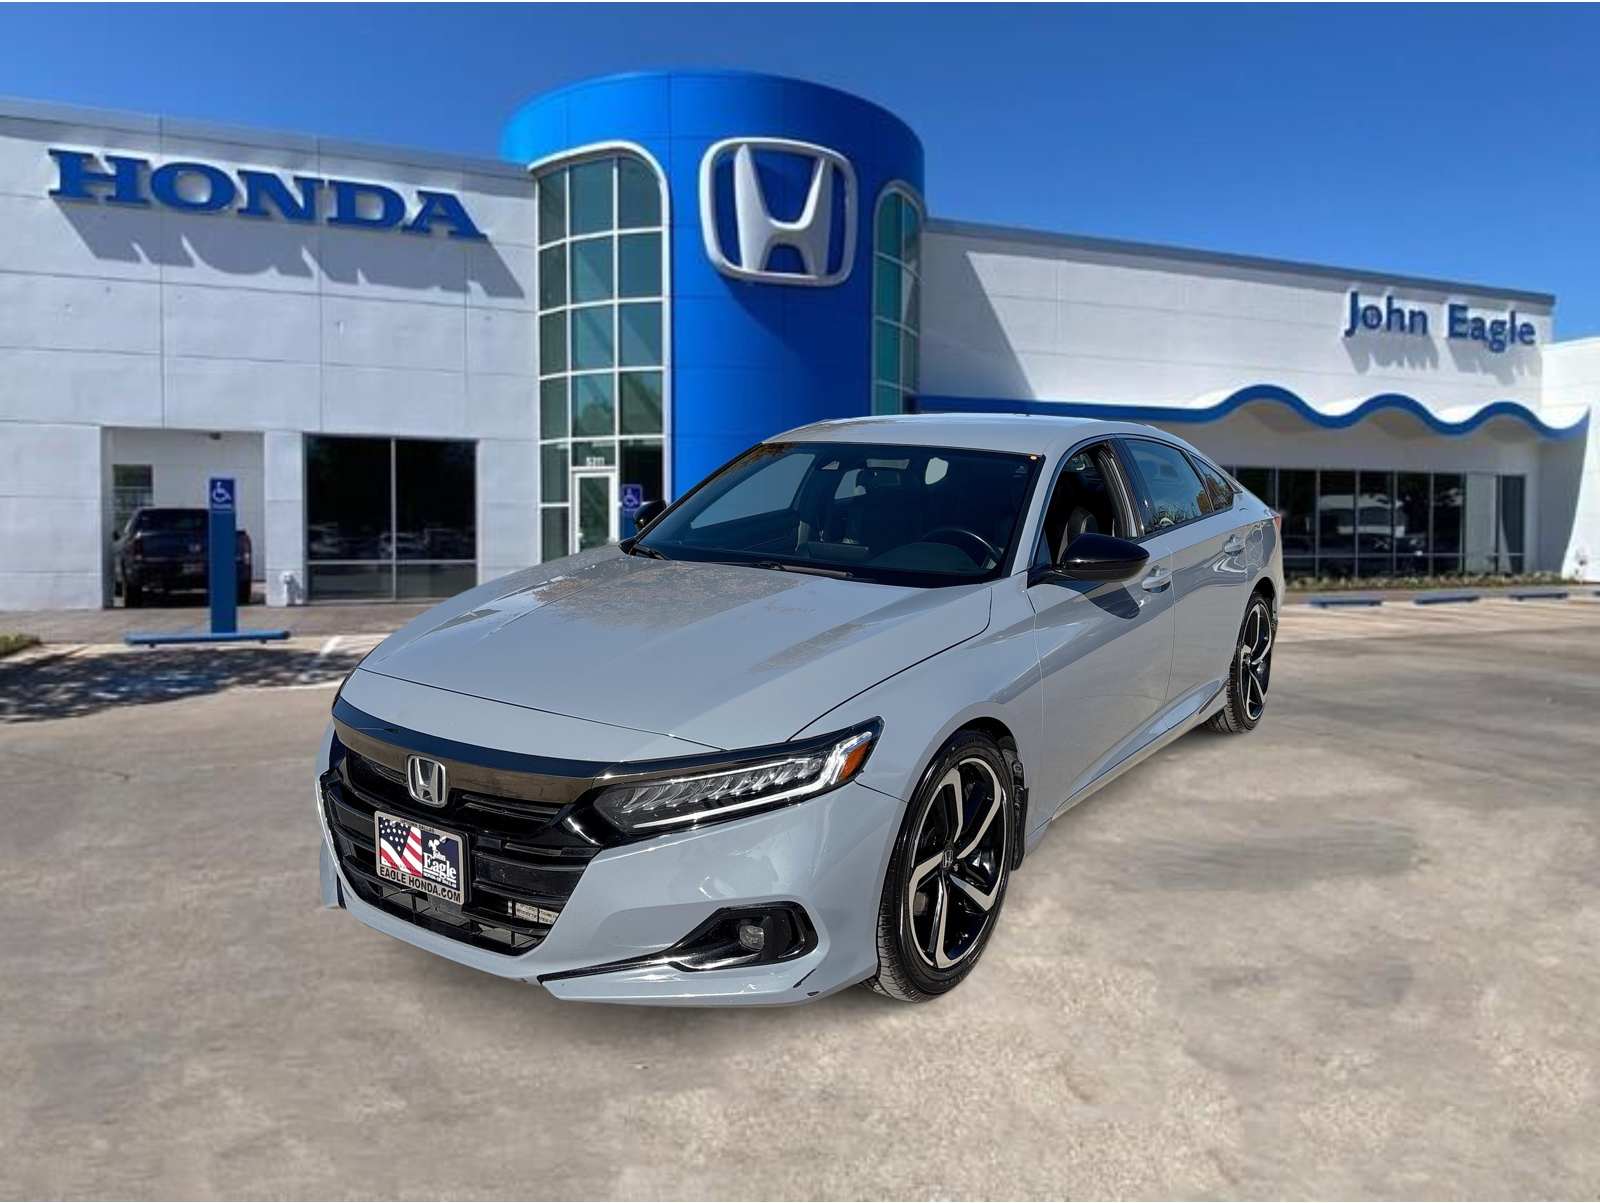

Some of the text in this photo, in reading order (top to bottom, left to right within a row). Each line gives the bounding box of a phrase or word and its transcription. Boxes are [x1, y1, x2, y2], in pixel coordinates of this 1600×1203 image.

[48, 148, 487, 240] HONDA
[1344, 290, 1536, 353] John Eagle
[423, 852, 457, 880] Eagle
[408, 876, 461, 903] HONDA.COM
